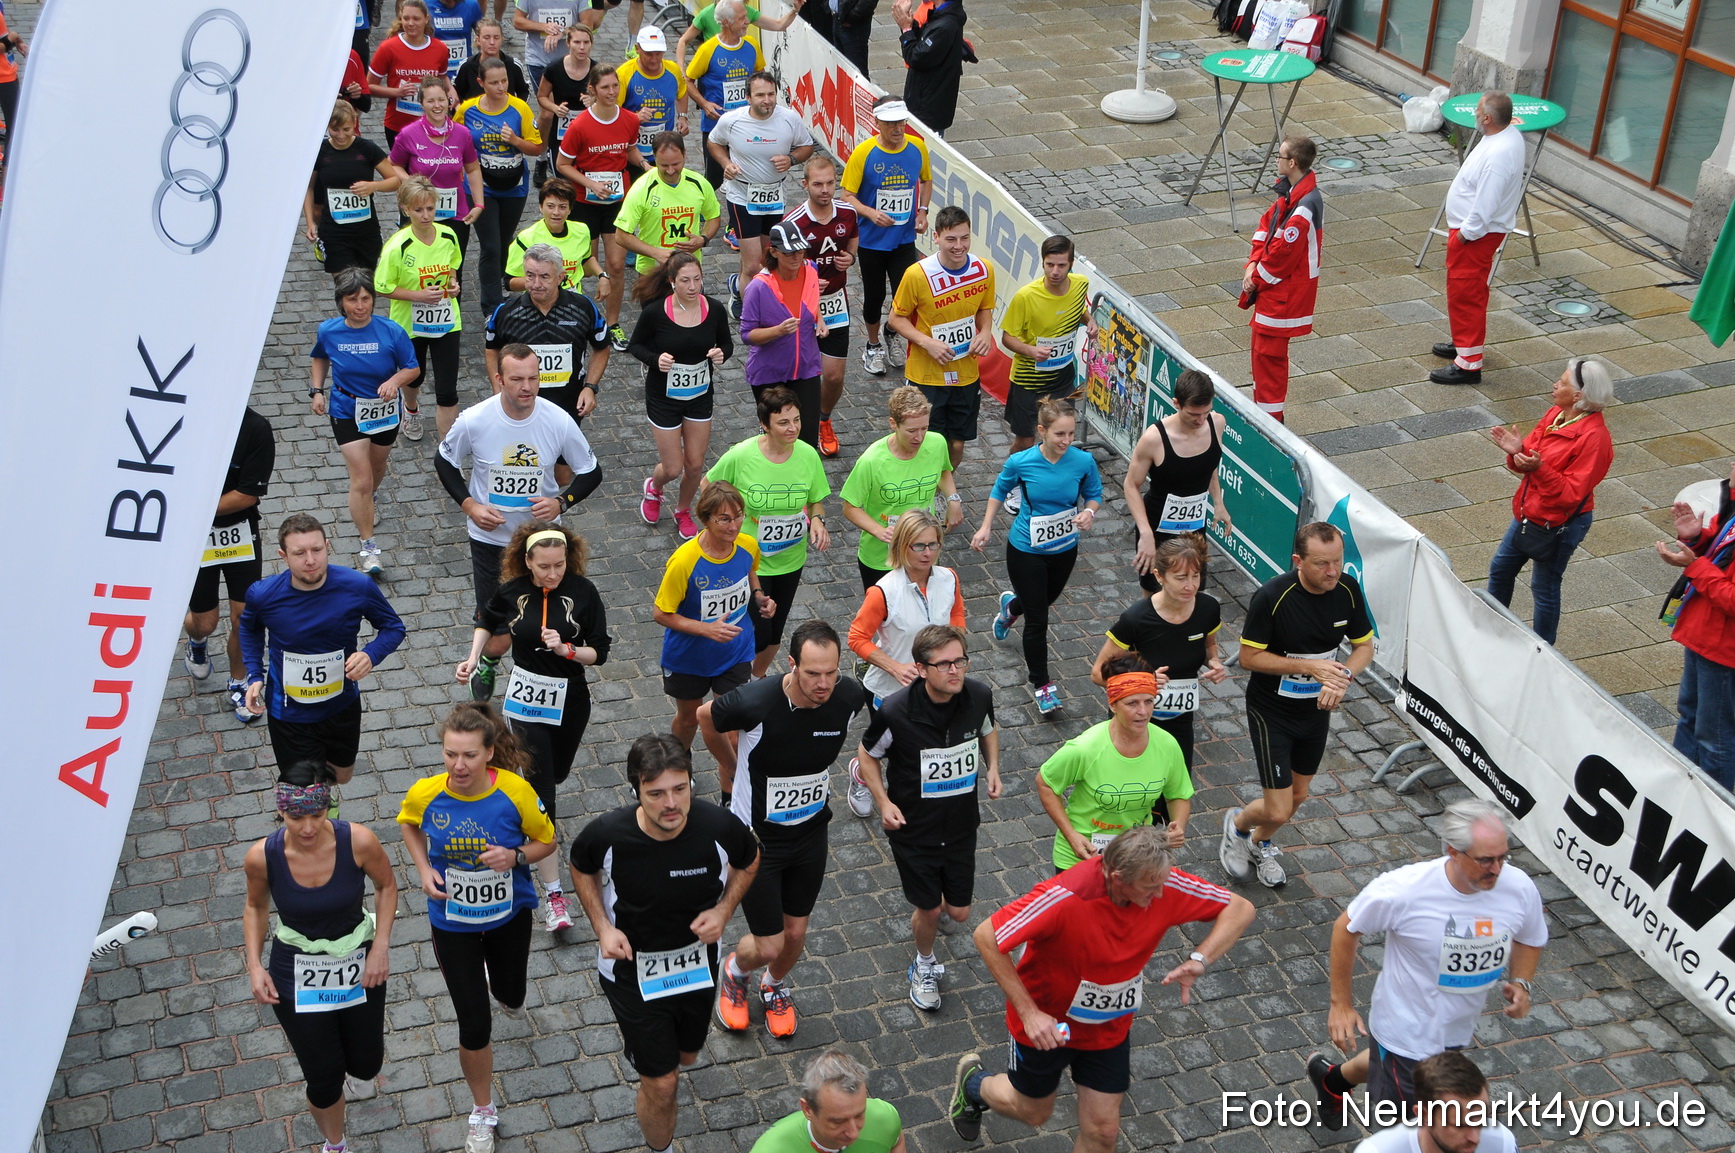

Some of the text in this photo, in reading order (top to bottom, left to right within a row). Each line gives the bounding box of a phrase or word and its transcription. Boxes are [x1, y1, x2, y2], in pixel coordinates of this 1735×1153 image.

[434, 17, 464, 26] HUBER
[546, 16, 567, 27] 653
[395, 68, 435, 77] NEUMARKT
[727, 87, 746, 102] 230
[588, 142, 625, 155] NEUMARKT
[333, 195, 368, 210] 2405
[751, 189, 780, 203] 2663
[661, 205, 695, 216] Müller
[880, 197, 910, 212] 2410
[417, 263, 450, 277] Müller
[561, 258, 578, 267] ller
[935, 281, 988, 310] MAX BÖGL
[820, 299, 843, 317] 932
[415, 308, 452, 324] 2072
[932, 318, 968, 335] PARTL Neumarkt
[1049, 339, 1074, 359] 579
[671, 370, 707, 388] 3317
[360, 400, 396, 421] 2615
[489, 468, 508, 476] PARTL
[1218, 456, 1243, 496] heit
[493, 476, 538, 495] 3328
[1167, 502, 1203, 521] 2943
[208, 527, 241, 547] 188
[762, 521, 803, 542] 2372
[1036, 518, 1074, 544] 2833
[214, 547, 238, 559] Stefan
[1238, 544, 1257, 570] 6352
[58, 335, 196, 808] Audi BKK
[707, 589, 747, 618] 2104
[285, 656, 335, 665] PARTL Neumarkt
[301, 666, 328, 684] 45
[529, 677, 557, 688] Neumarkt
[300, 686, 330, 697] Markus
[511, 680, 559, 708] 2341
[1291, 683, 1323, 694] Bernhar
[1153, 691, 1194, 711] 2448
[521, 706, 542, 717] Petra
[921, 753, 944, 762] PARTL
[928, 752, 976, 781] 2319
[1455, 735, 1472, 758] die
[1471, 750, 1520, 809] verbinden
[768, 777, 822, 789] PARTL Neumarkt
[936, 778, 969, 792] Rüdiger
[773, 783, 823, 810] 2256
[784, 808, 810, 820] Martin
[1093, 838, 1110, 846] PART
[1563, 753, 1735, 966] SW
[447, 871, 502, 886] PARTL Neumarkt
[675, 866, 708, 878] PFLEIDERER
[451, 881, 508, 905] 2096
[1553, 826, 1701, 975] stadtwerke
[457, 905, 501, 919] Katarzyna
[296, 956, 355, 968] PARTL Neumarkt
[644, 948, 702, 978] 2144
[1447, 946, 1505, 973] 3329
[302, 961, 361, 988] 2712
[661, 974, 690, 989] Bernd
[317, 992, 347, 1004] Katrin
[1080, 987, 1136, 1011] 3348
